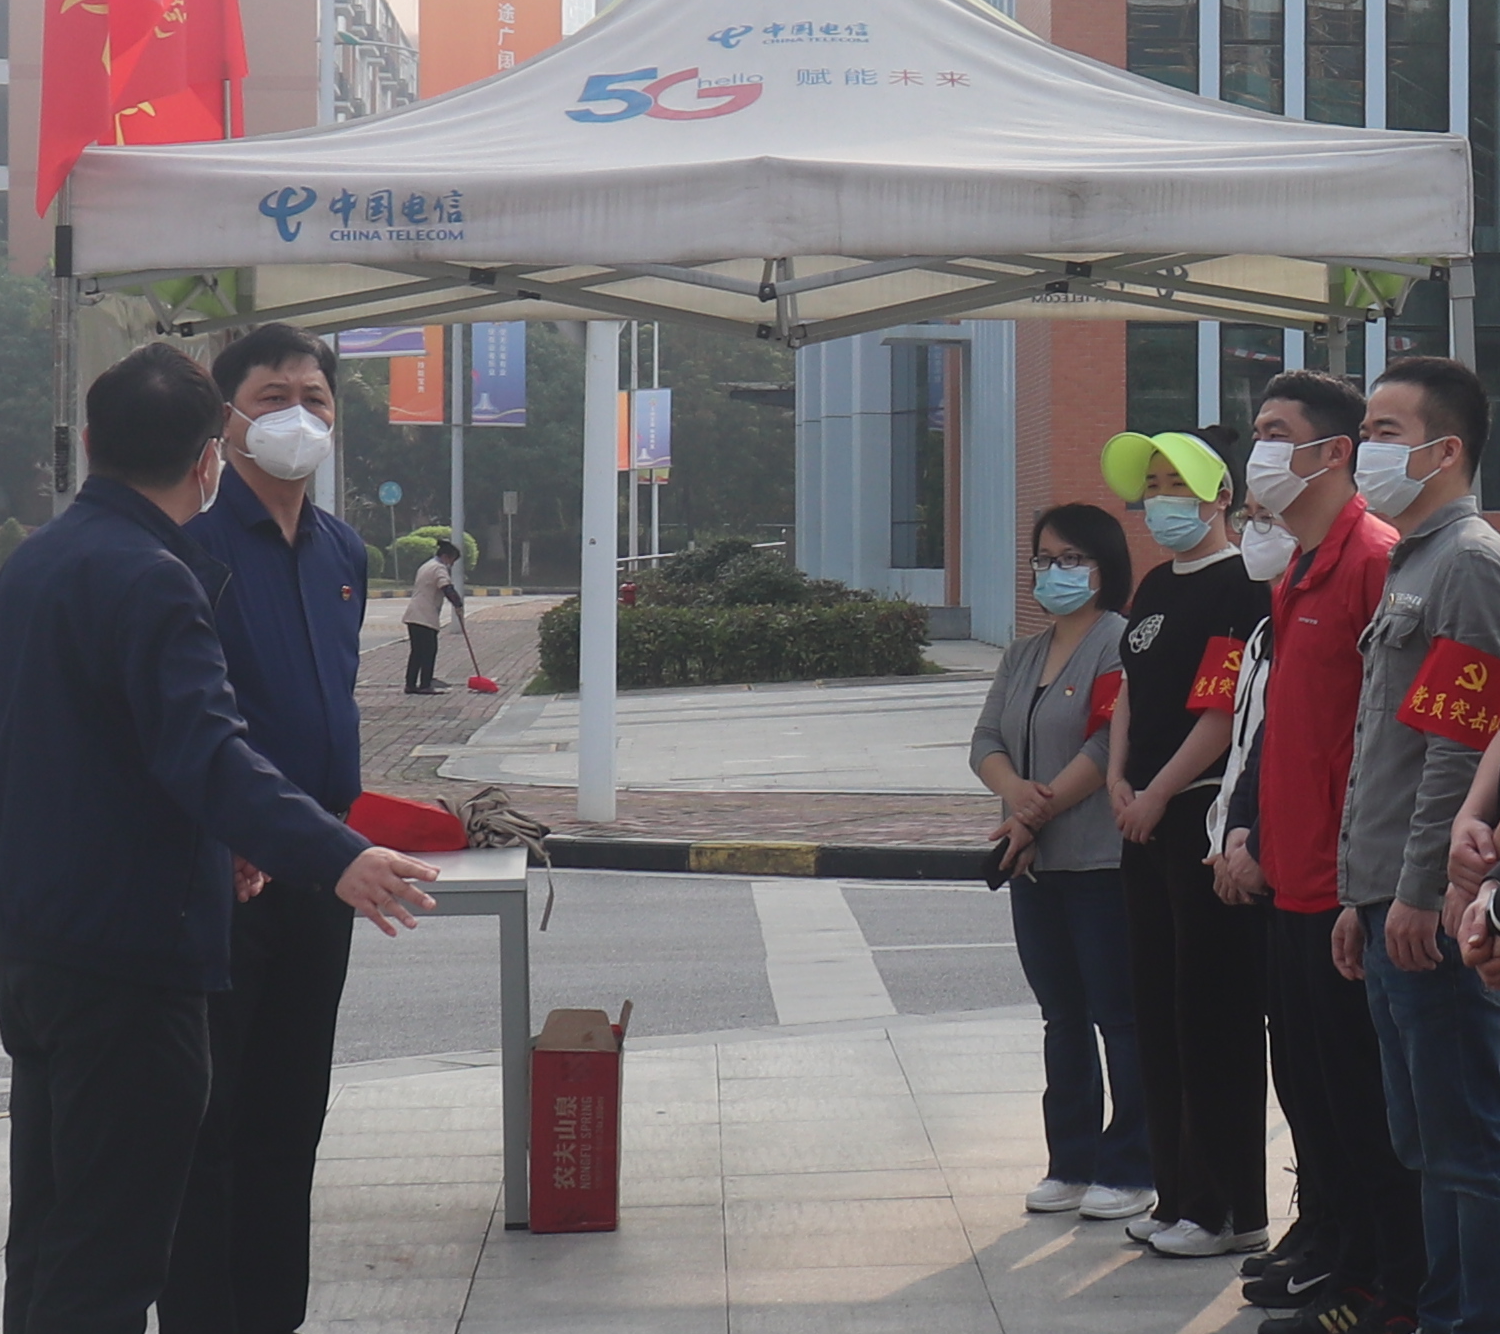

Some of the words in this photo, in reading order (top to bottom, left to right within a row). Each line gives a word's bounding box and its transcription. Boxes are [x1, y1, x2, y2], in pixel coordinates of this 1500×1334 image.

[762, 21, 869, 38] 中国电信
[699, 72, 764, 90] hello
[796, 67, 971, 89] 赋能未来
[329, 188, 464, 228] 中国电信
[330, 229, 382, 241] CHINA
[386, 229, 464, 241] TELECOM
[581, 1096, 592, 1140] SPRING
[553, 1095, 577, 1189] 农夫山泉
[581, 1144, 592, 1190] NONGFU
